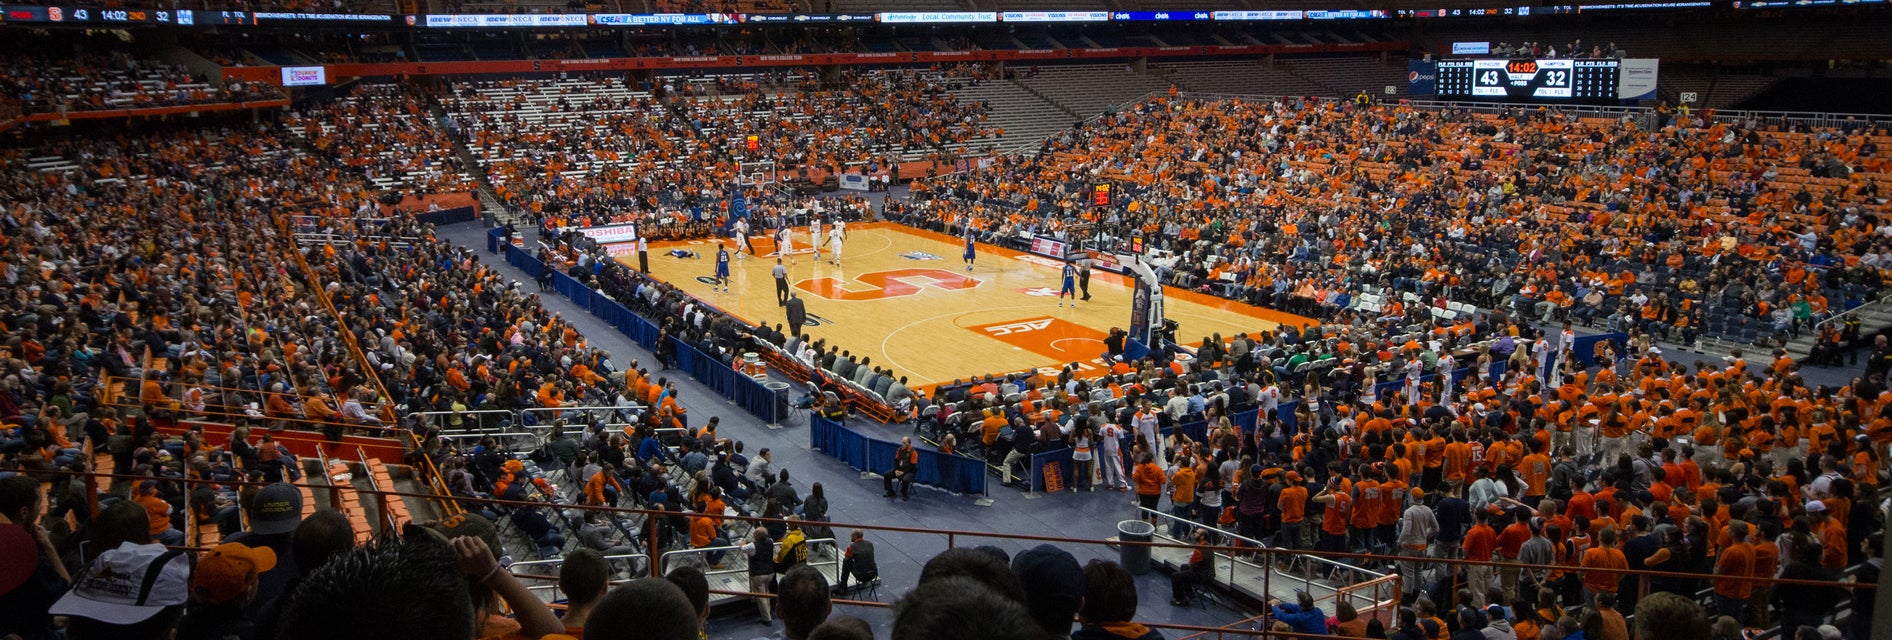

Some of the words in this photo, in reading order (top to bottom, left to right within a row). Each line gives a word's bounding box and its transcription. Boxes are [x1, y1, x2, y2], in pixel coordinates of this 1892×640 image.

[74, 10, 88, 20] 43
[101, 10, 127, 20] 14:02
[156, 12, 169, 21] 32
[1509, 62, 1536, 72] 14:02
[1480, 70, 1498, 85] 43
[1546, 70, 1565, 86] 32
[748, 140, 758, 149] 35
[580, 228, 632, 236] OSHIBA
[984, 318, 1054, 336] ACC
[1271, 390, 1277, 398] S
[1107, 428, 1114, 437] S
[1472, 451, 1482, 461] 15
